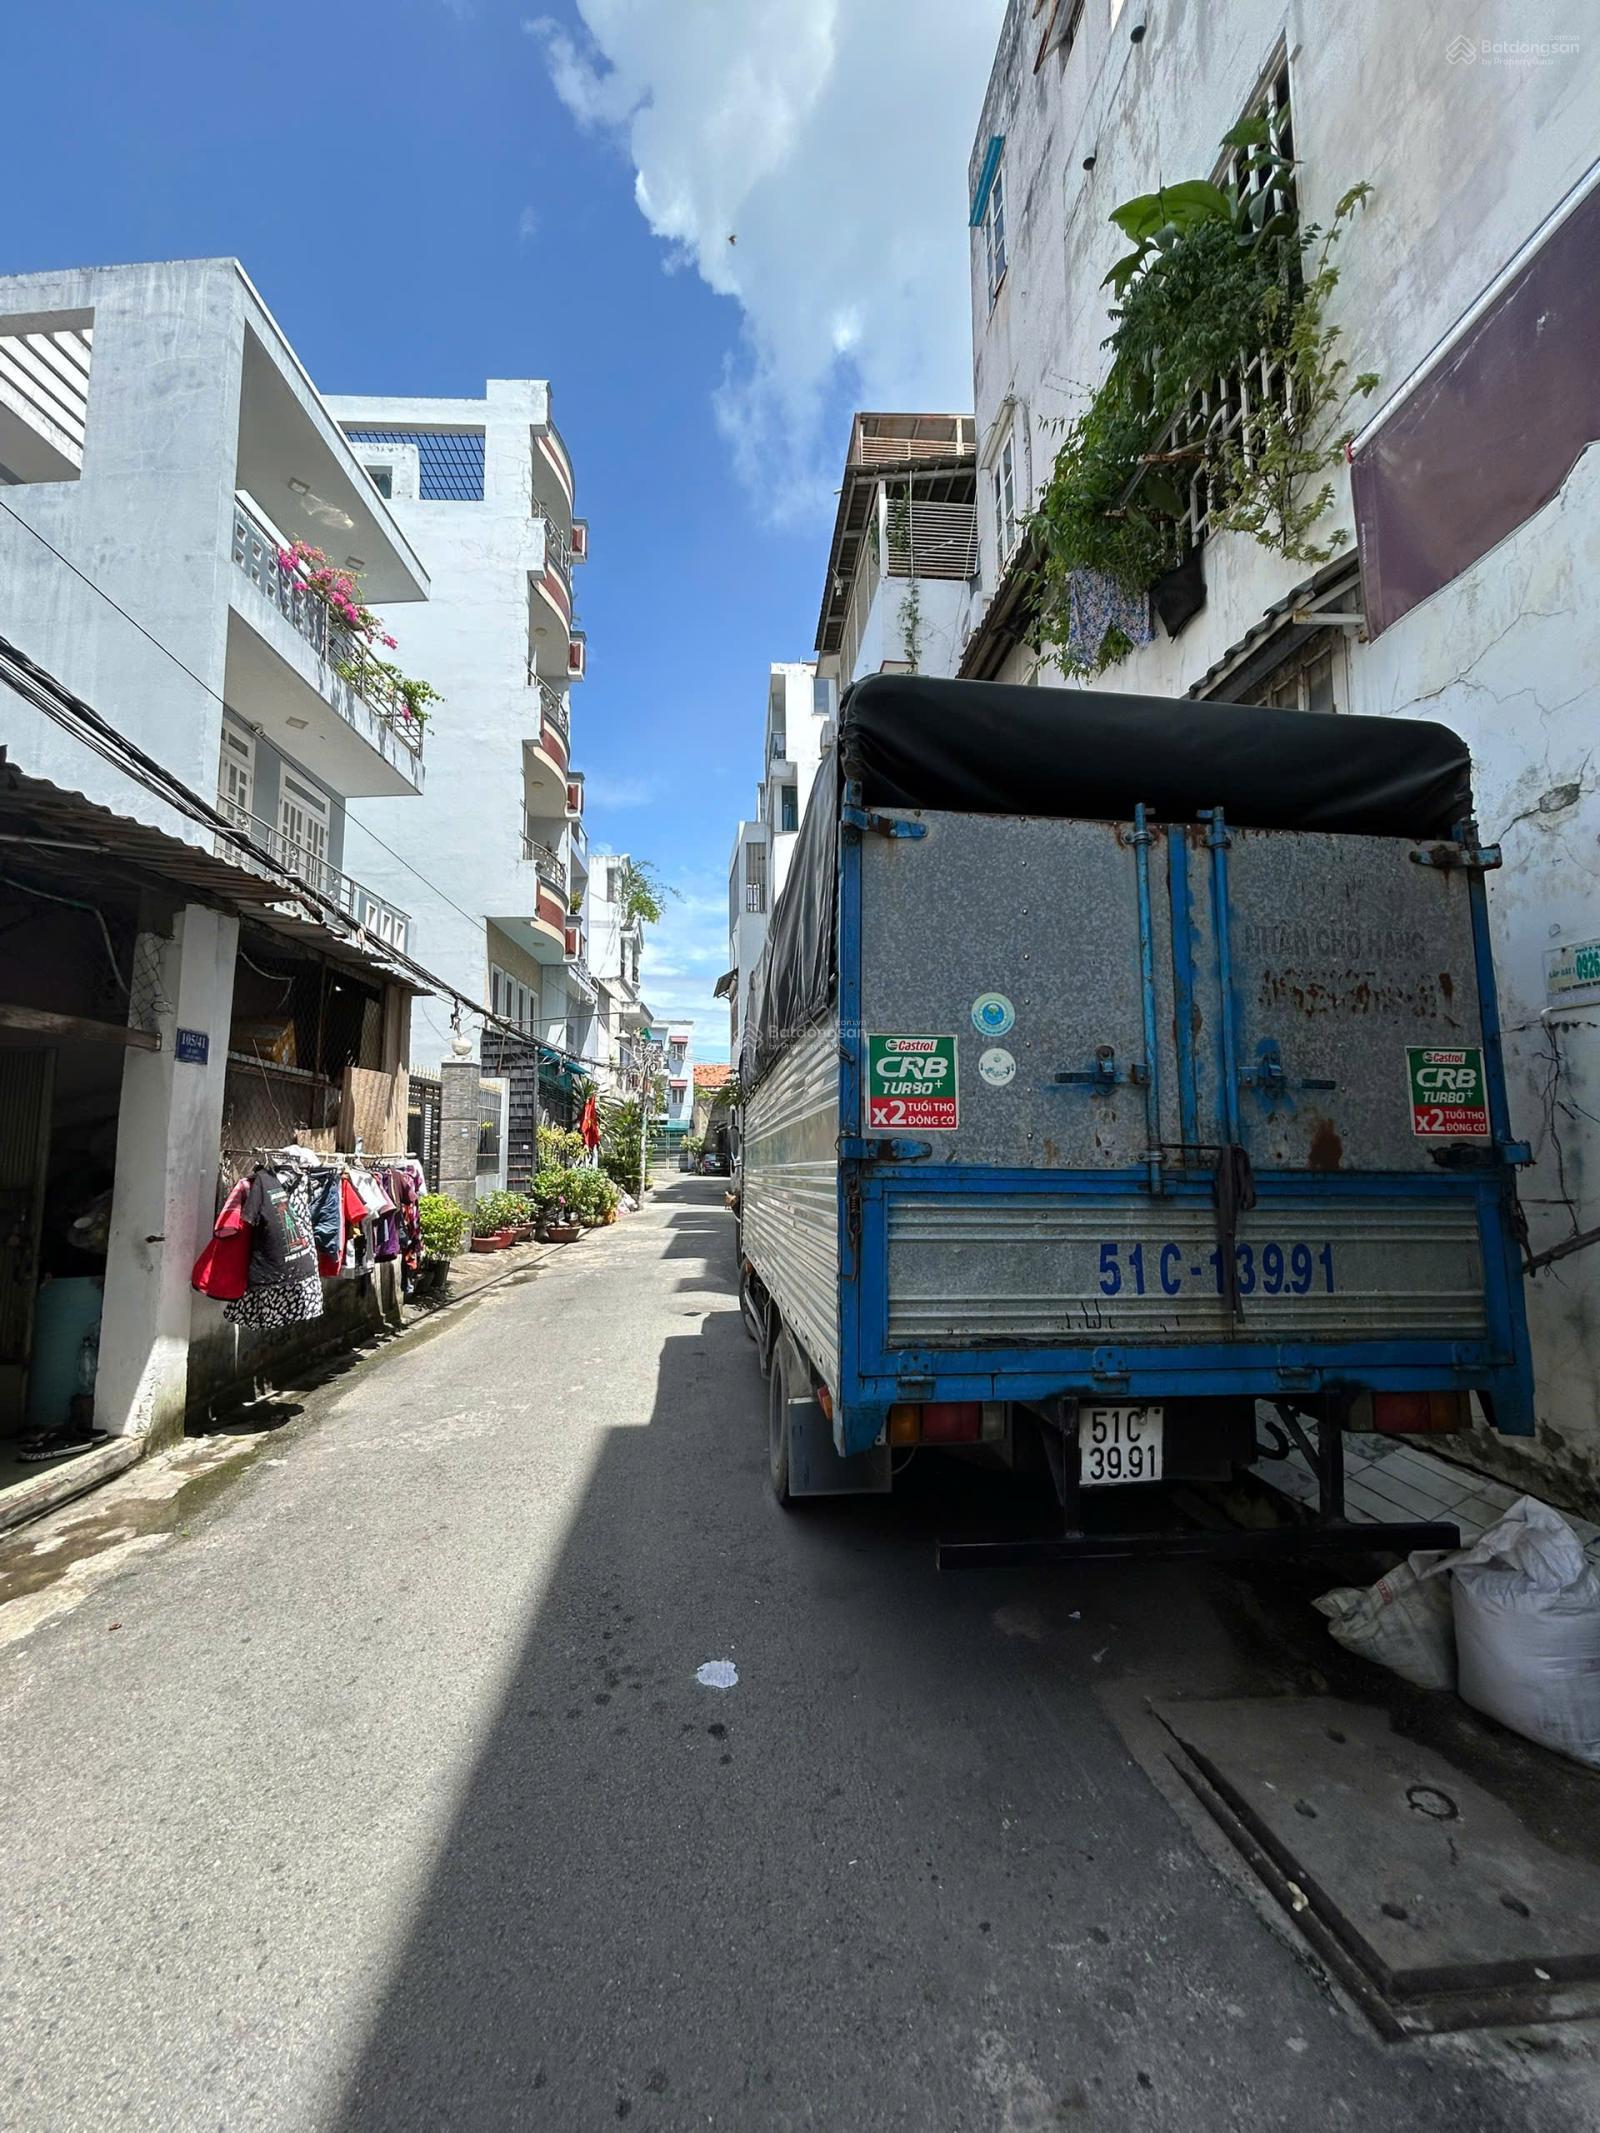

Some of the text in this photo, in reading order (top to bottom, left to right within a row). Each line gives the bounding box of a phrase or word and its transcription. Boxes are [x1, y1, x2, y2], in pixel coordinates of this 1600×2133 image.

[898, 1040, 934, 1051] Castrol
[1434, 1052, 1463, 1063] Castrol
[876, 1056, 949, 1080] CRB
[1416, 1067, 1477, 1090] CRB
[934, 1102, 955, 1113] THỌ
[908, 1114, 939, 1127] ĐỘNG
[1466, 1111, 1484, 1121] THỌ
[1446, 1122, 1472, 1133] ĐỘNG
[1092, 1411, 1141, 1444] 51C
[1080, 1444, 1155, 1480] 39.91
